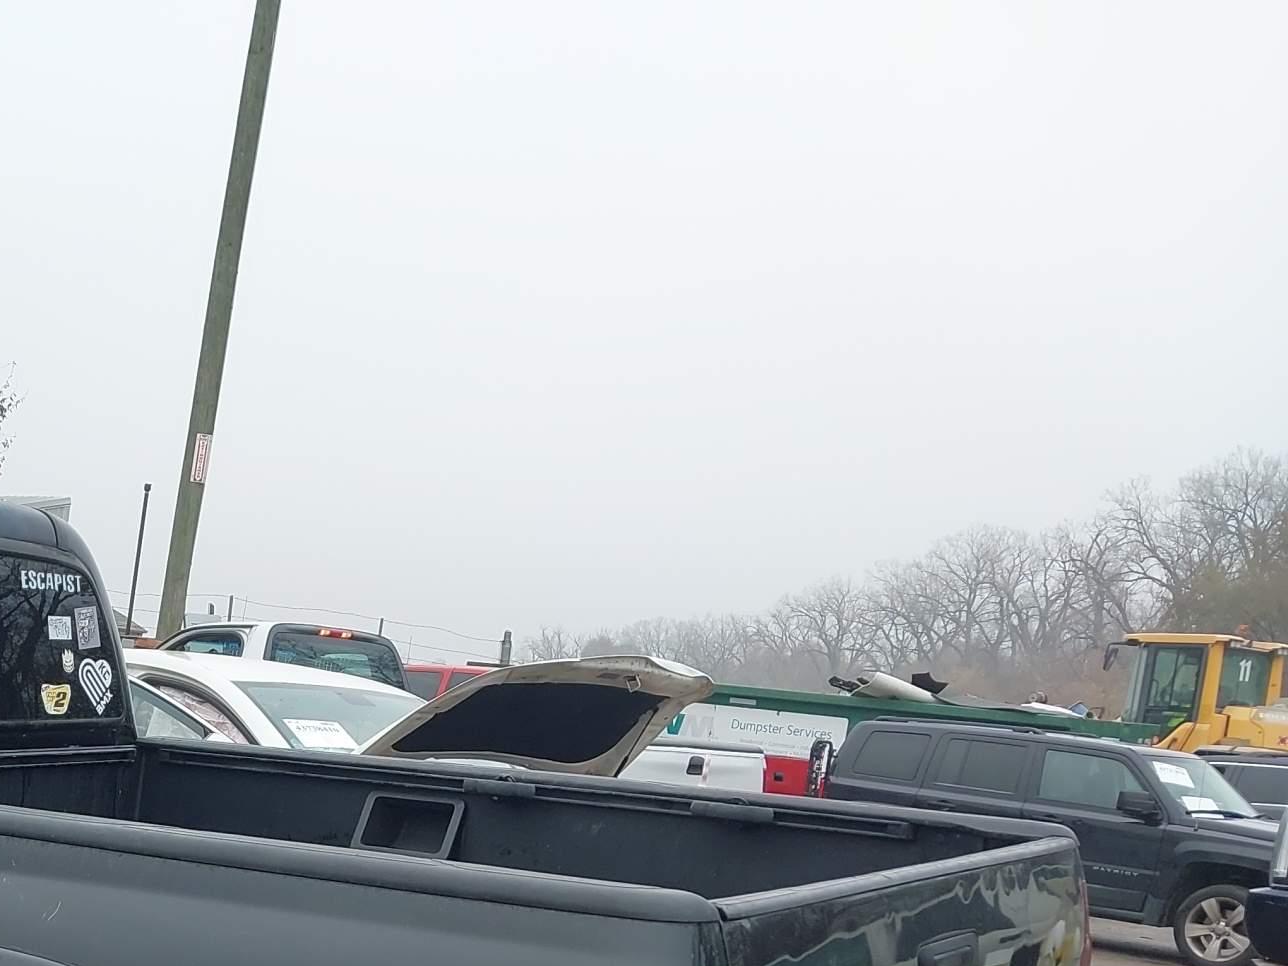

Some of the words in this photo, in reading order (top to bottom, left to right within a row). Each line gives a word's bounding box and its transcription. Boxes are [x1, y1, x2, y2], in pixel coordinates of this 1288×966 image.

[20, 570, 82, 593] ESCAPIST
[1239, 659, 1252, 682] 11
[54, 692, 67, 707] 2
[96, 689, 114, 716] BMX
[730, 719, 783, 736] Dumpster
[785, 725, 832, 740] Services
